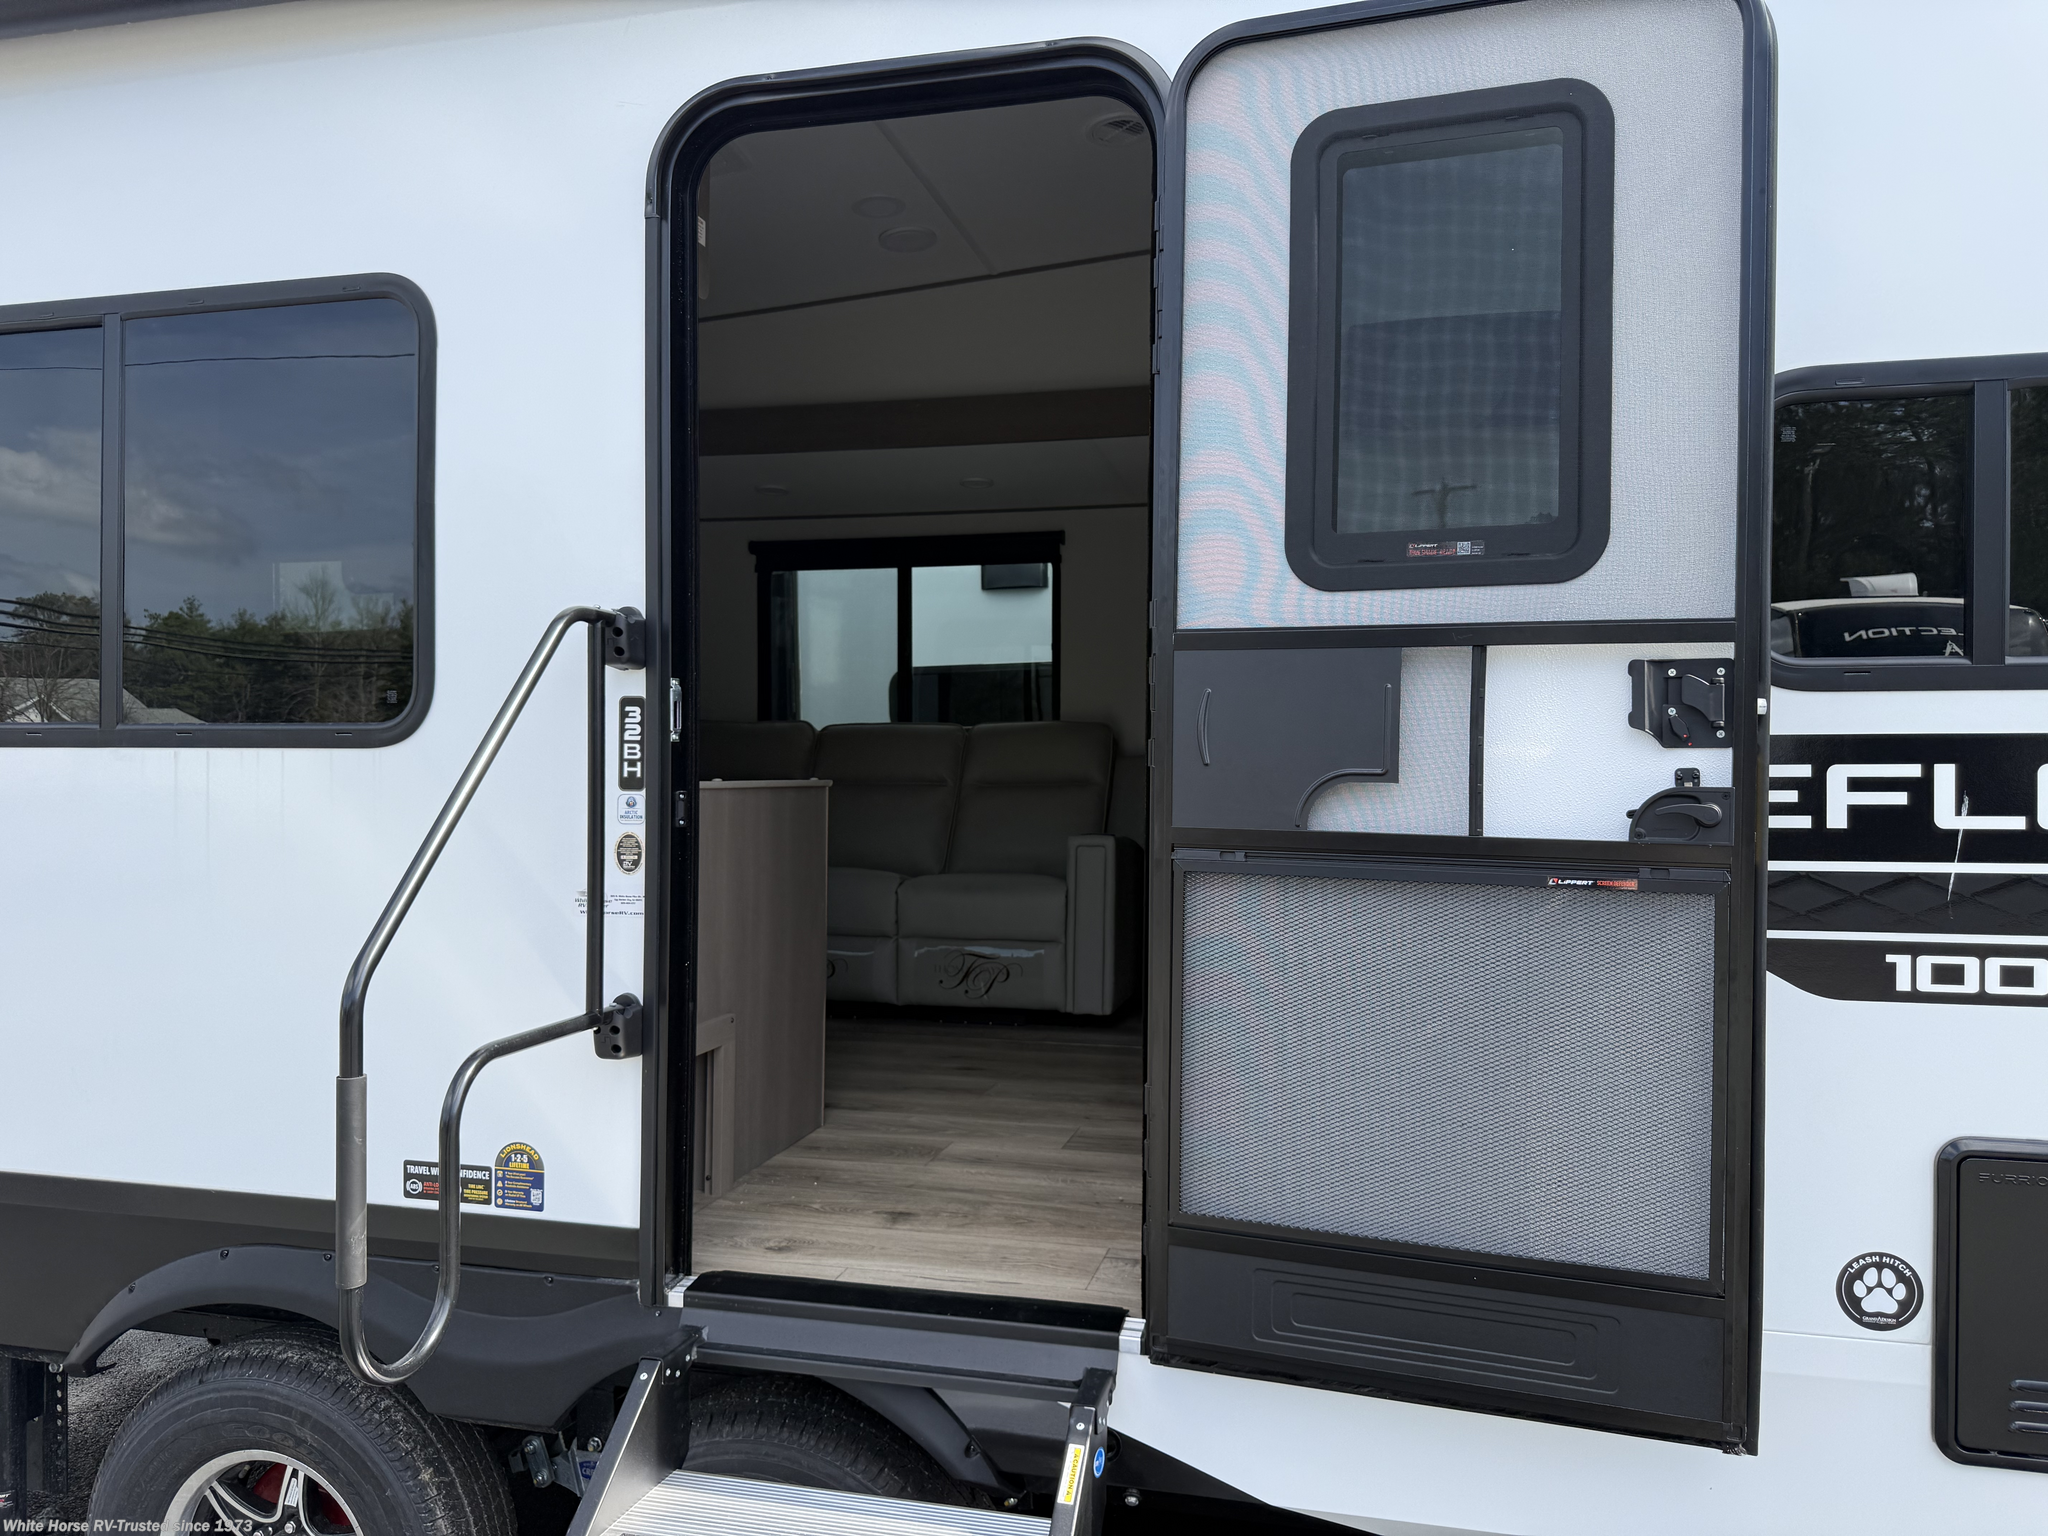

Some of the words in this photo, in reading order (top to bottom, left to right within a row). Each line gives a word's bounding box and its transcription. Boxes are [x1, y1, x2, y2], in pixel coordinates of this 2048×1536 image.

[623, 706, 642, 778] 32BH
[1768, 763, 2048, 830] EFL
[500, 1143, 539, 1161] LIONSHEAD
[406, 1165, 430, 1175] TRAVEL
[430, 1167, 440, 1176] WI
[460, 1169, 490, 1180] NFIDENCE
[1847, 1255, 1880, 1273] LEASH
[1882, 1255, 1912, 1277] HITCH
[1068, 1458, 1079, 1490] CAUTION
